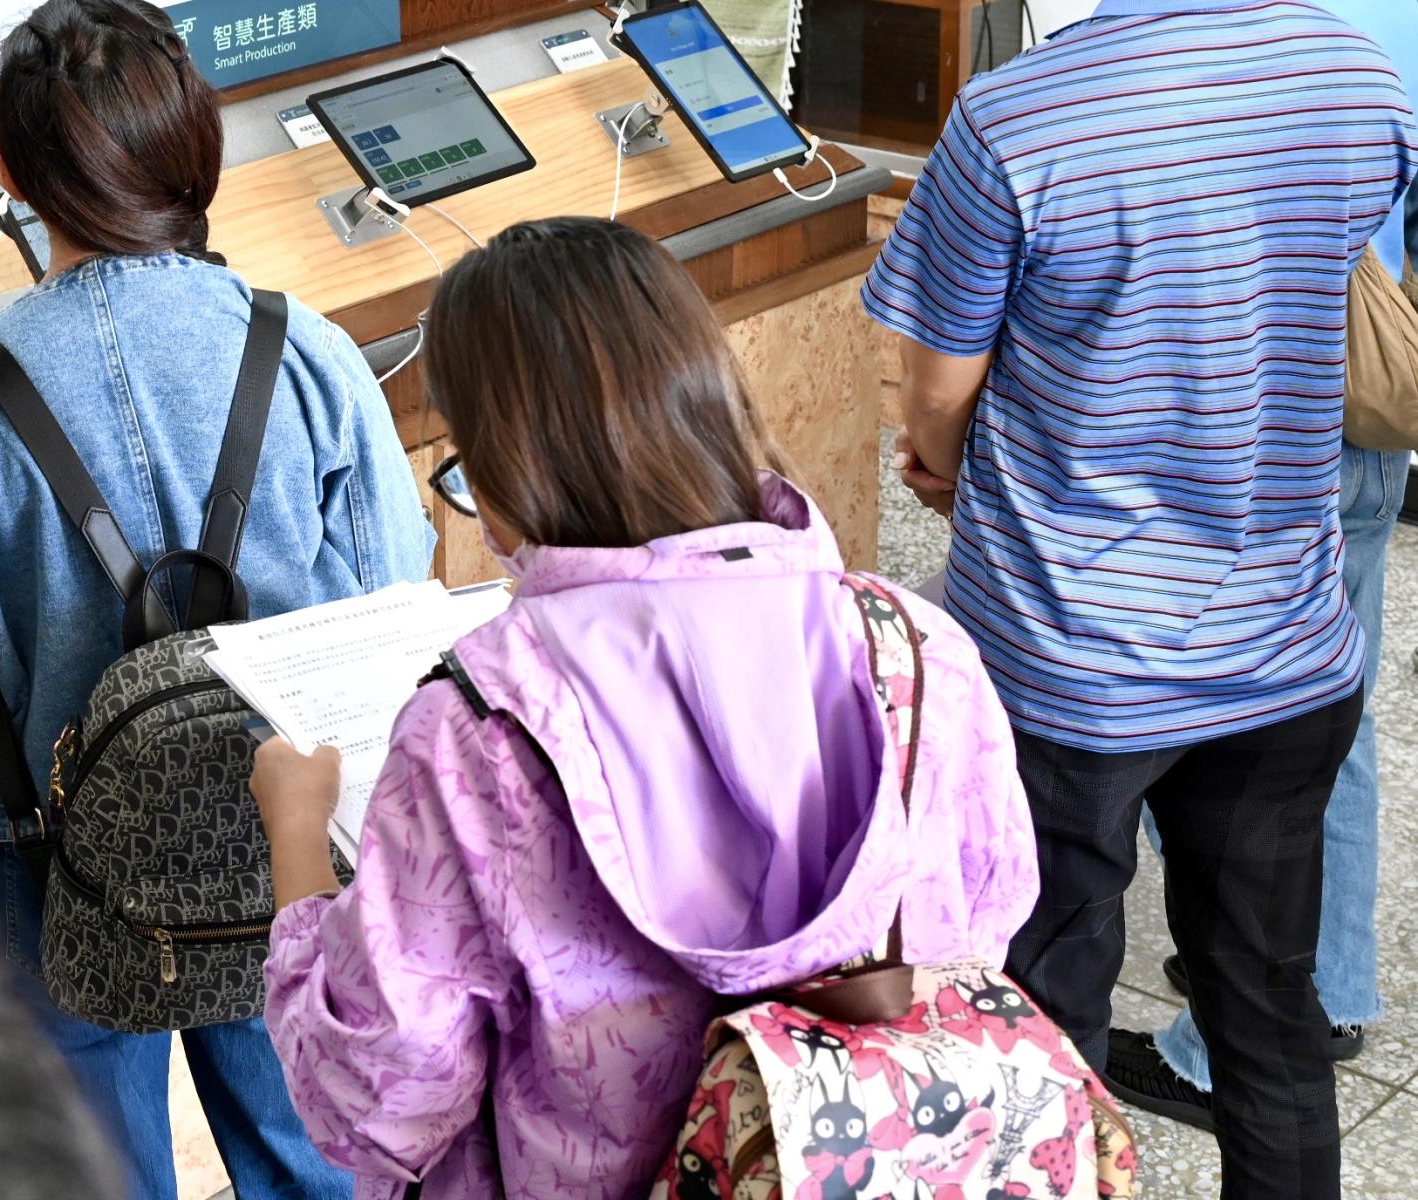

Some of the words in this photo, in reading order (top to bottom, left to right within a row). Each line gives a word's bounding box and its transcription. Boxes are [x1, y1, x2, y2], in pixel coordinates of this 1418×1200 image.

[213, 2, 317, 51] 智慧生產類
[214, 56, 242, 70] Smart
[244, 41, 296, 62] Production
